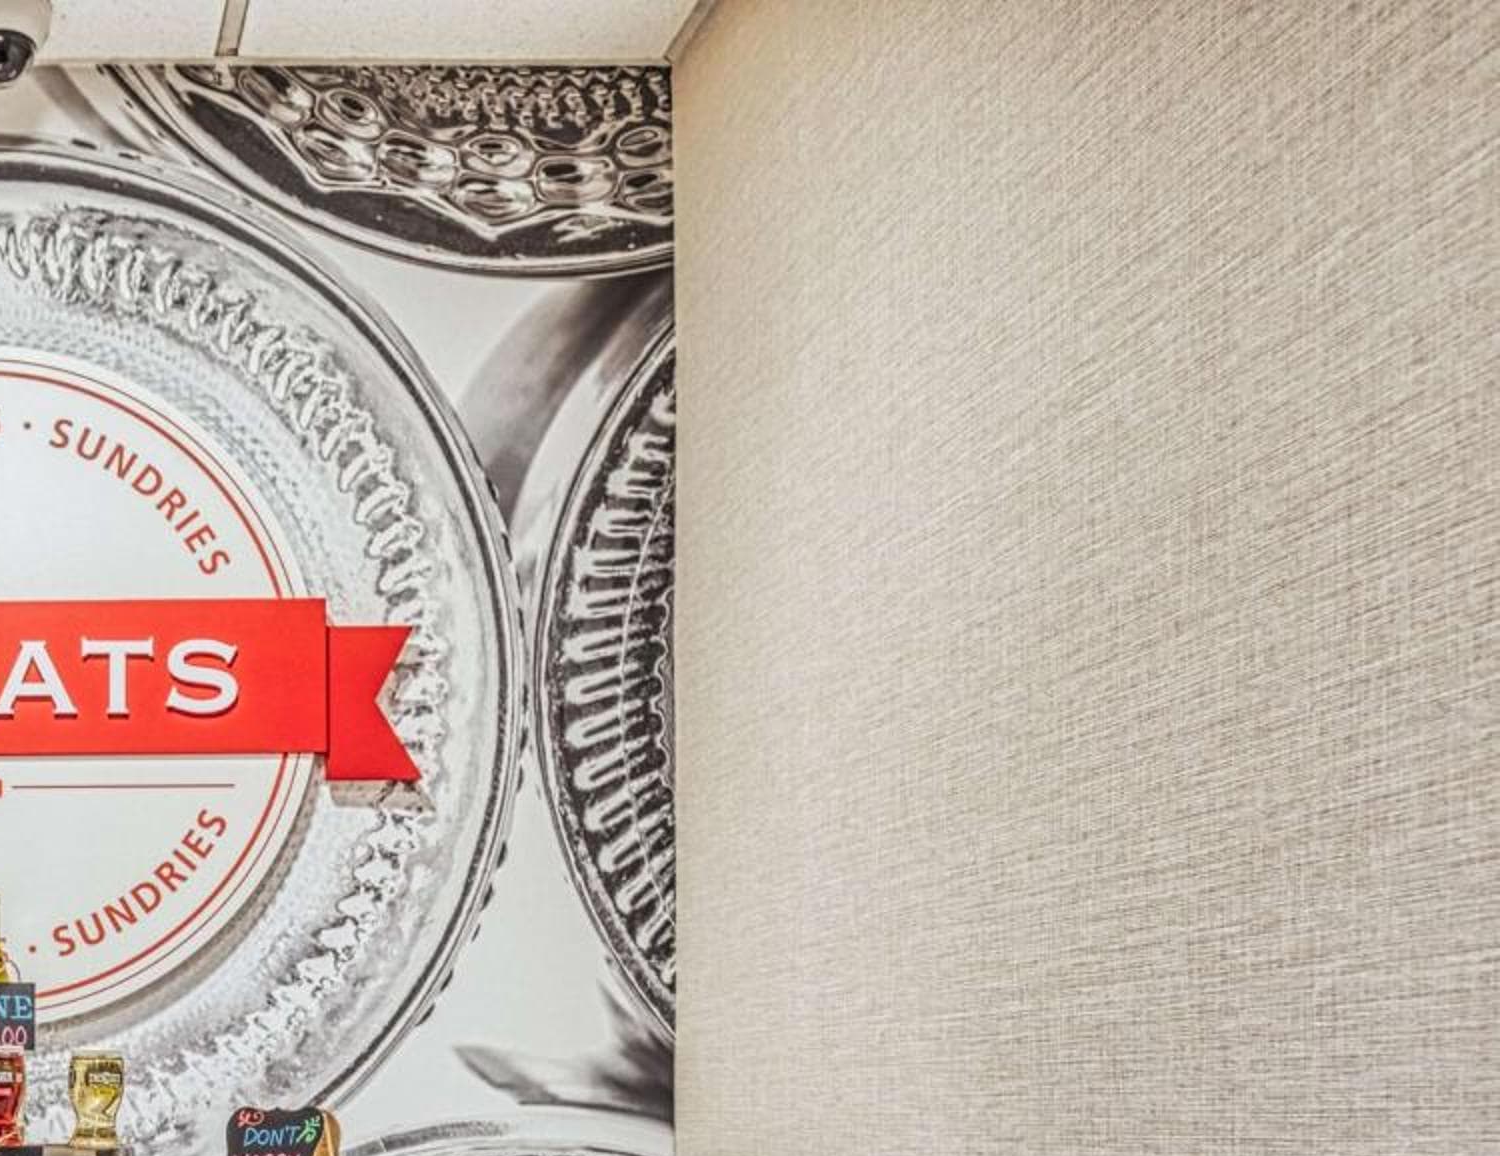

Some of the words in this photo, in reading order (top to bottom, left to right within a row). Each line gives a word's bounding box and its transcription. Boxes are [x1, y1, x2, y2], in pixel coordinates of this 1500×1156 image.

[49, 417, 232, 577] SUNDRIES
[52, 808, 228, 957] SUNDRIES
[243, 1125, 300, 1147] DON'T
